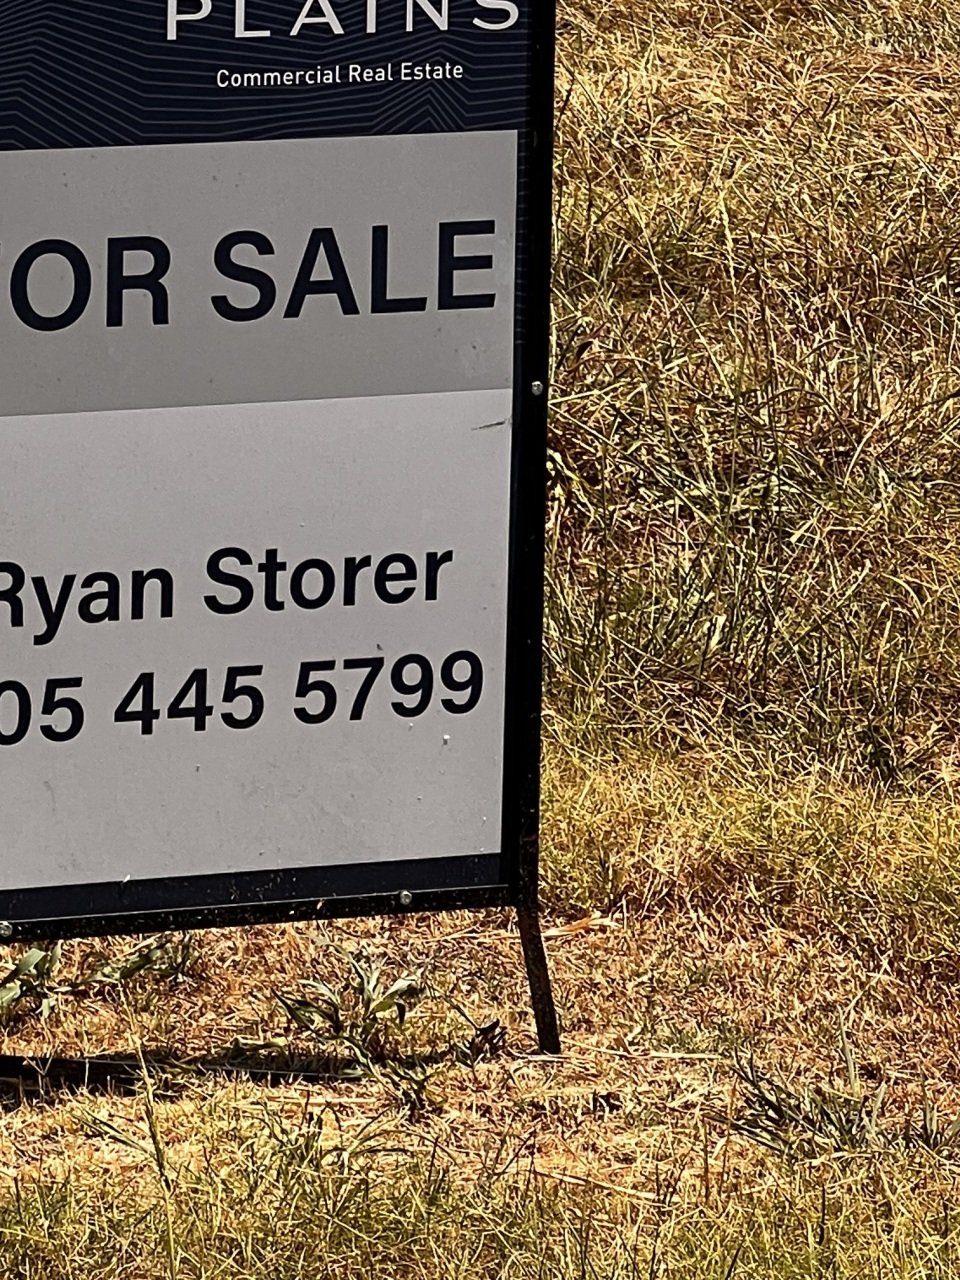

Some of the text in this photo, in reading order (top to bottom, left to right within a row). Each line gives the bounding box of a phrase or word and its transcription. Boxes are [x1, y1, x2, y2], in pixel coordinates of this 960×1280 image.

[216, 61, 464, 88] Commercial Real Estate
[210, 219, 497, 323] SALE
[203, 546, 454, 615] Storer
[113, 664, 265, 736] 445
[293, 650, 484, 725] 5799
